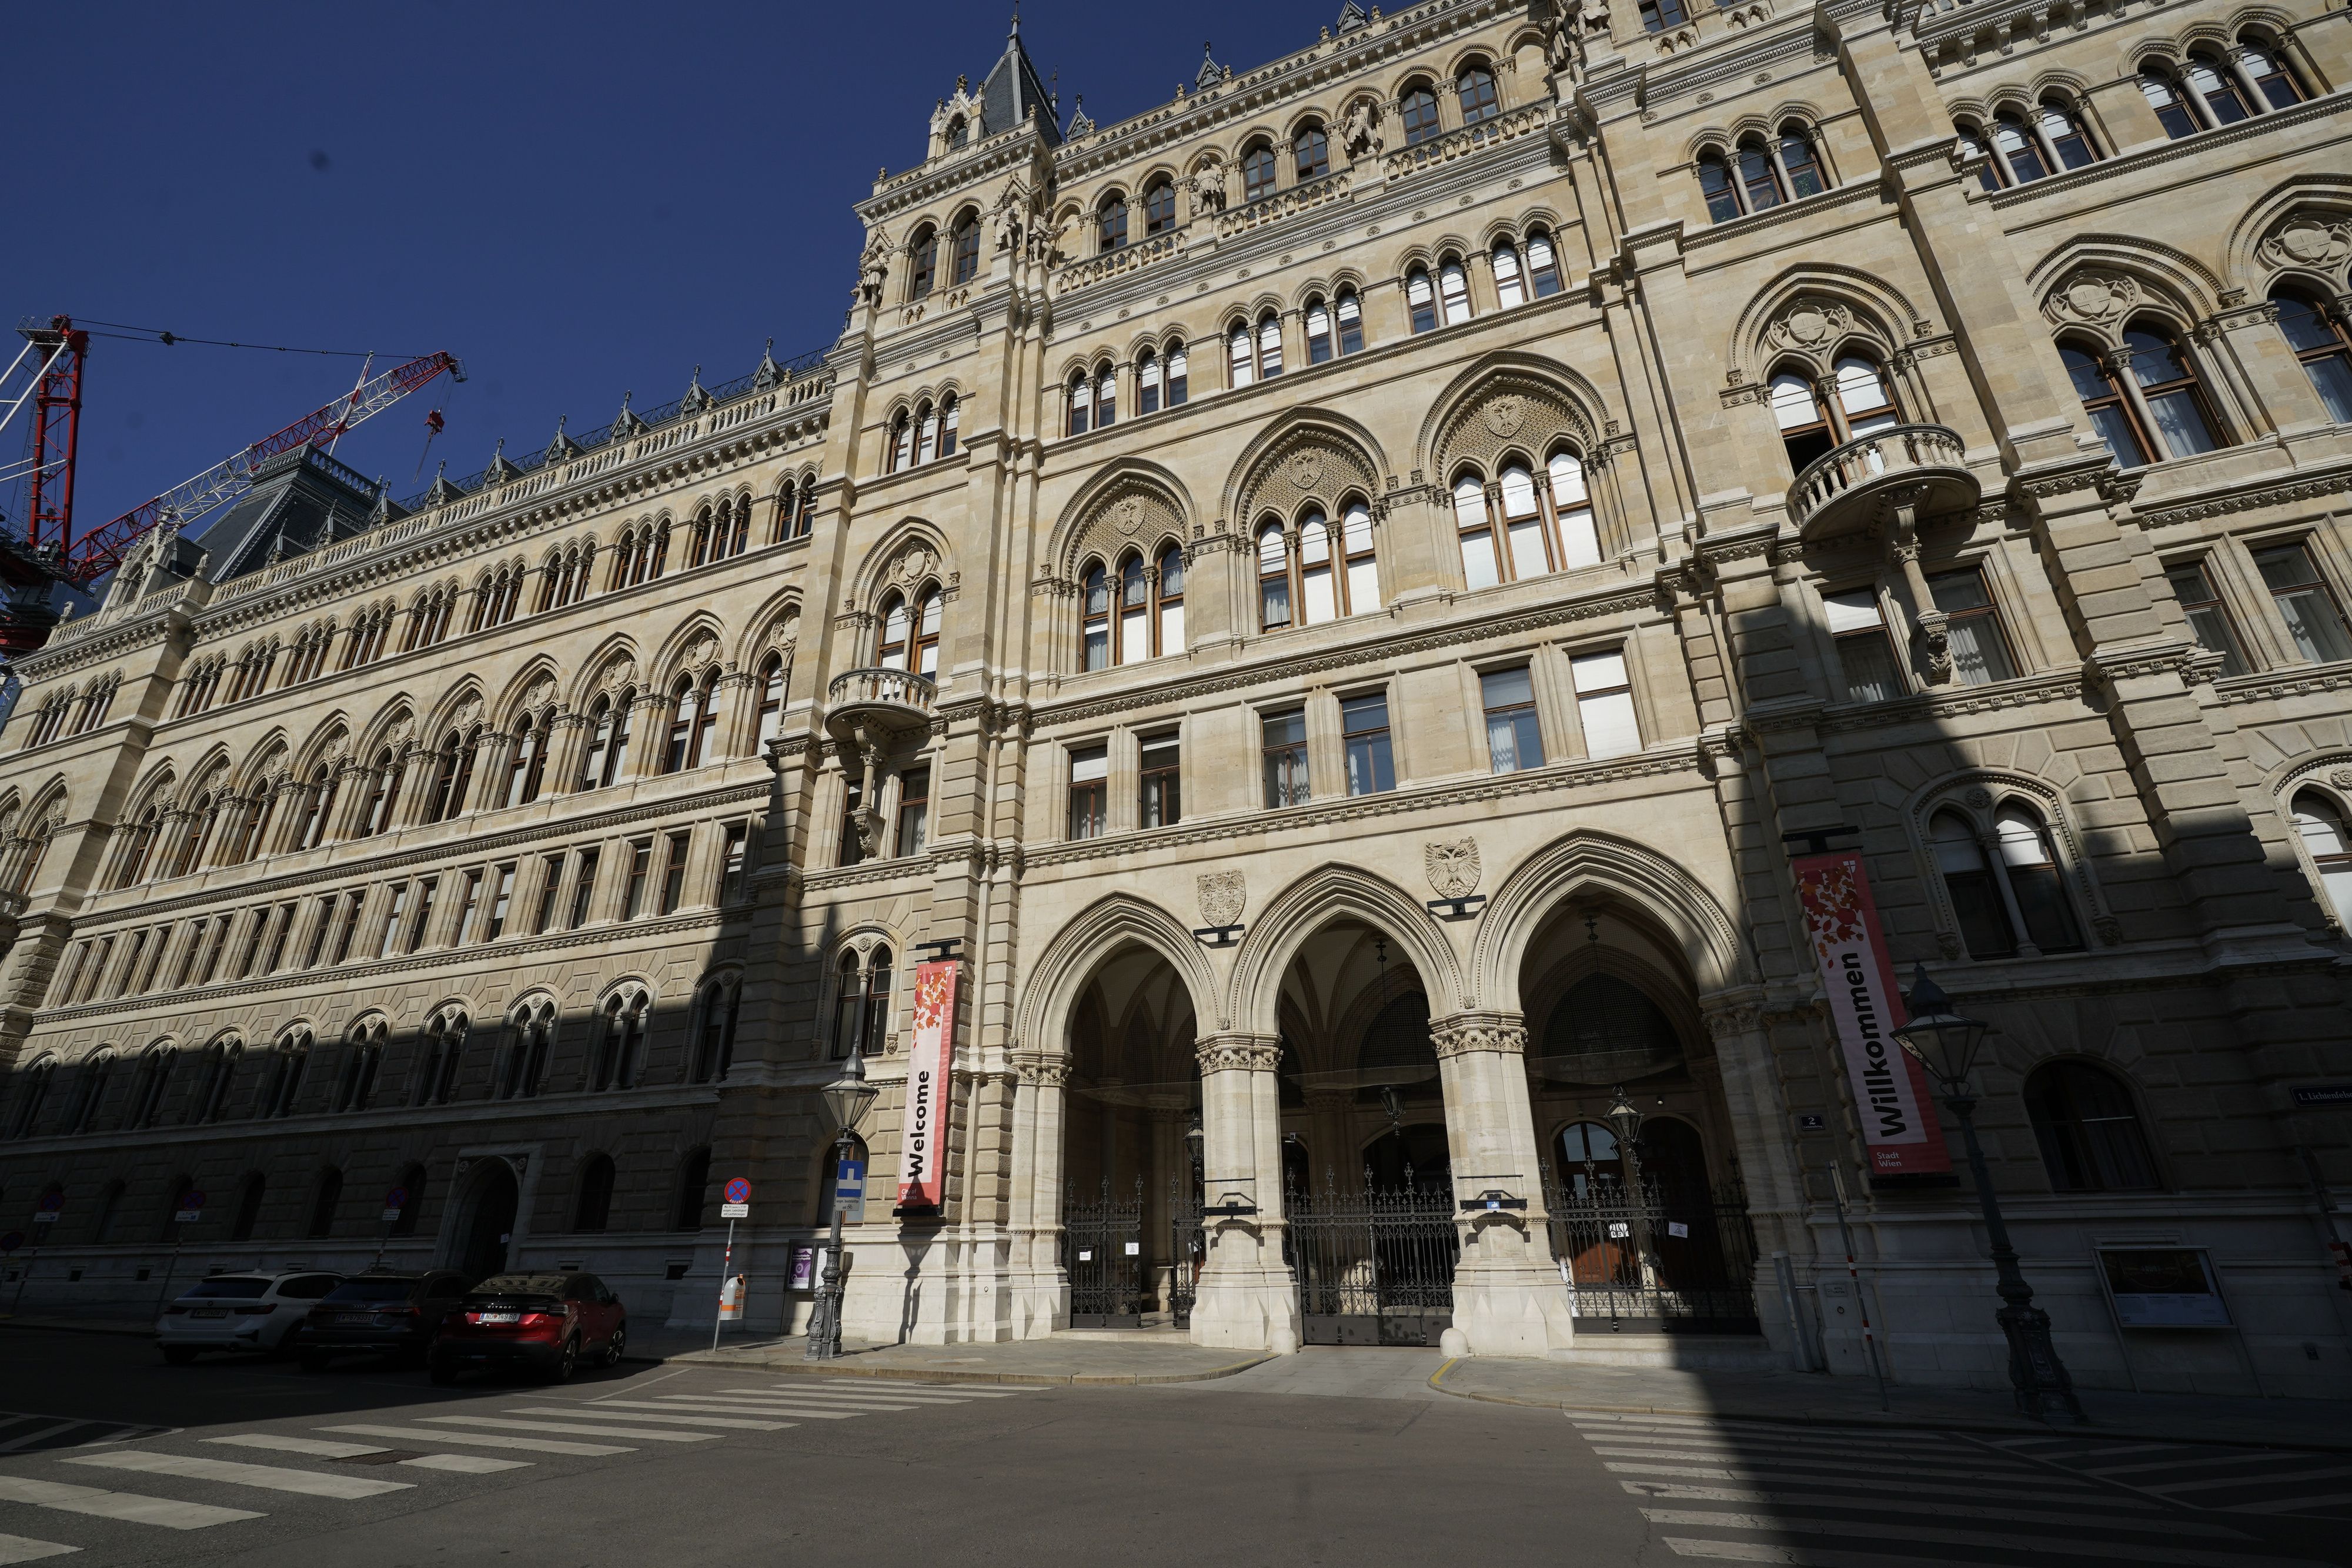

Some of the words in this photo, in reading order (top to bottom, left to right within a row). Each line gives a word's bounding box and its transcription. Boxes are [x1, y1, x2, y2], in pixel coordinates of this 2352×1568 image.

[1841, 952, 1907, 1138] Willkommen
[907, 1070, 930, 1178] Welcome
[1808, 1117, 1816, 1125] 2
